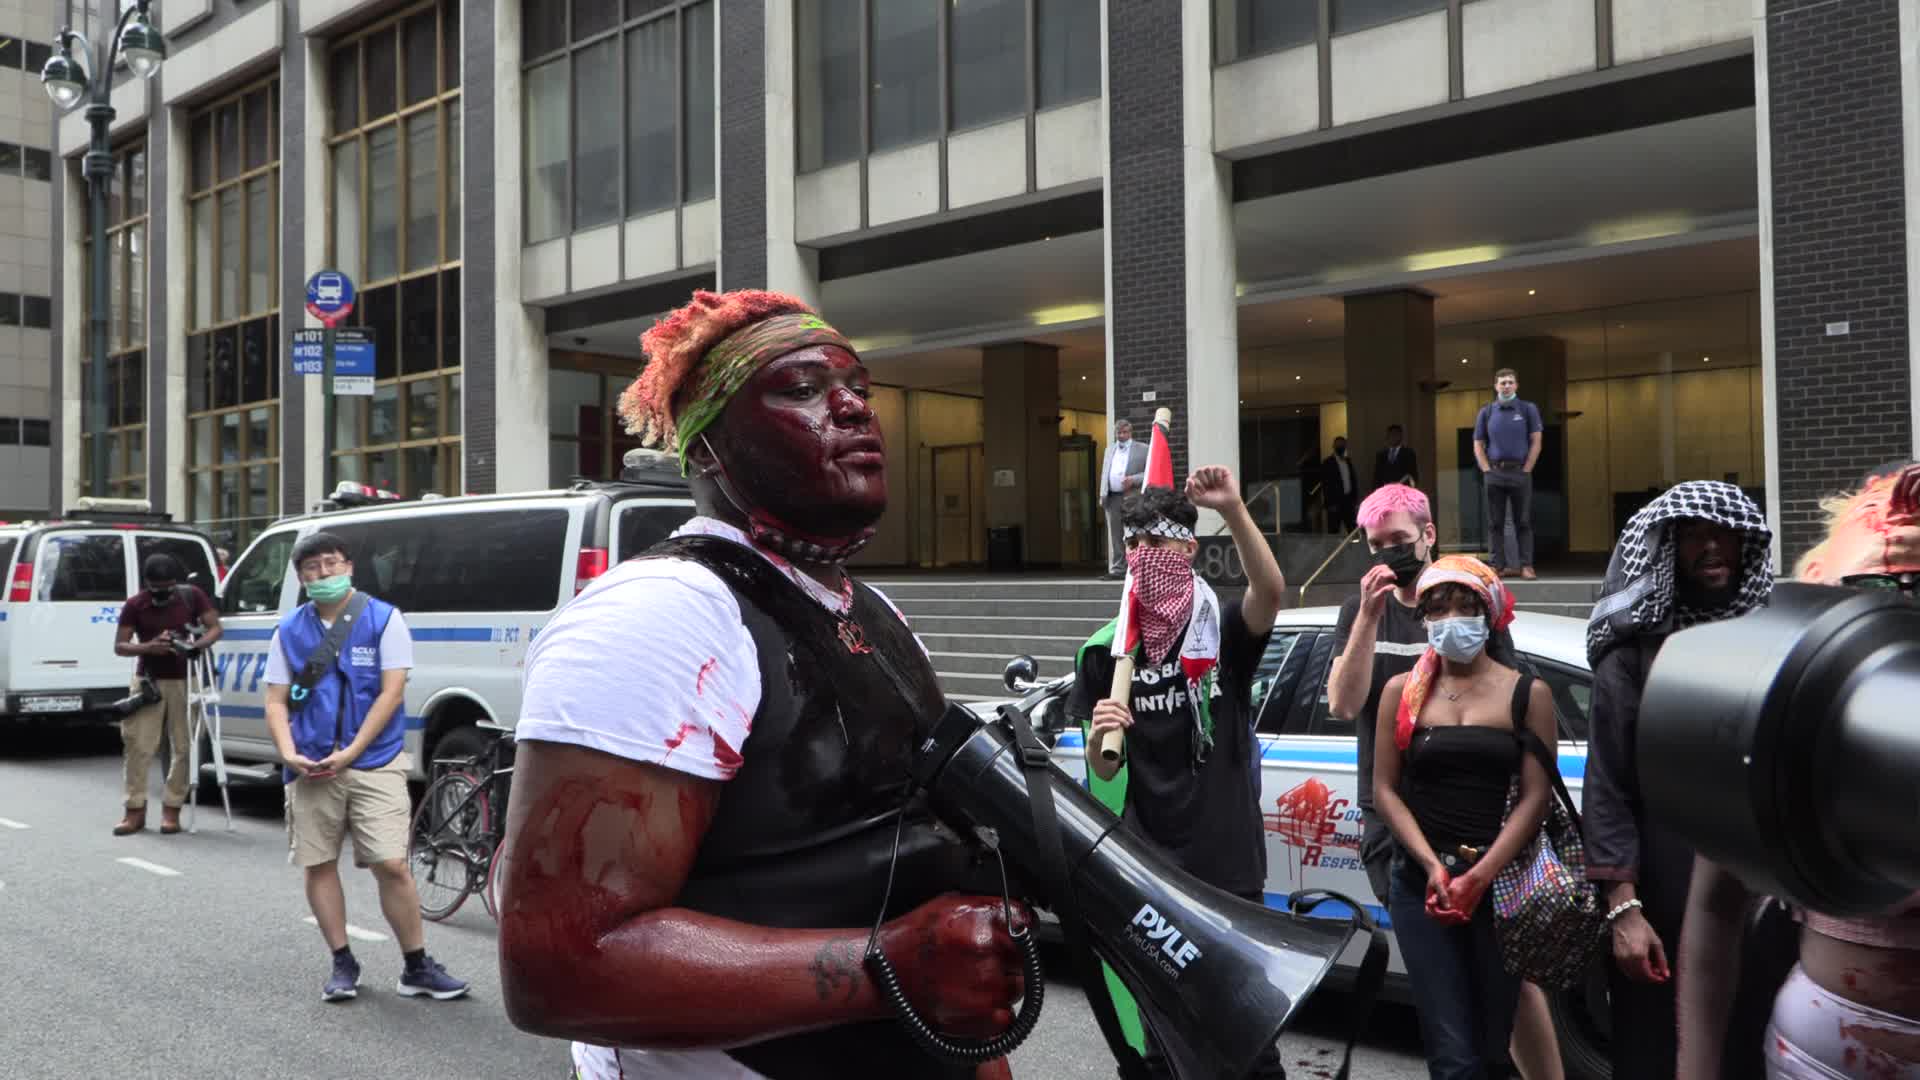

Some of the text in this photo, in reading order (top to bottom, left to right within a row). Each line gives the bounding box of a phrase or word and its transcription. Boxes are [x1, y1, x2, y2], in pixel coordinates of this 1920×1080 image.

[294, 331, 322, 342] M101
[293, 345, 322, 357] M102
[293, 360, 322, 372] M103
[1201, 543, 1243, 578] 80
[1131, 903, 1199, 969] PYLE
